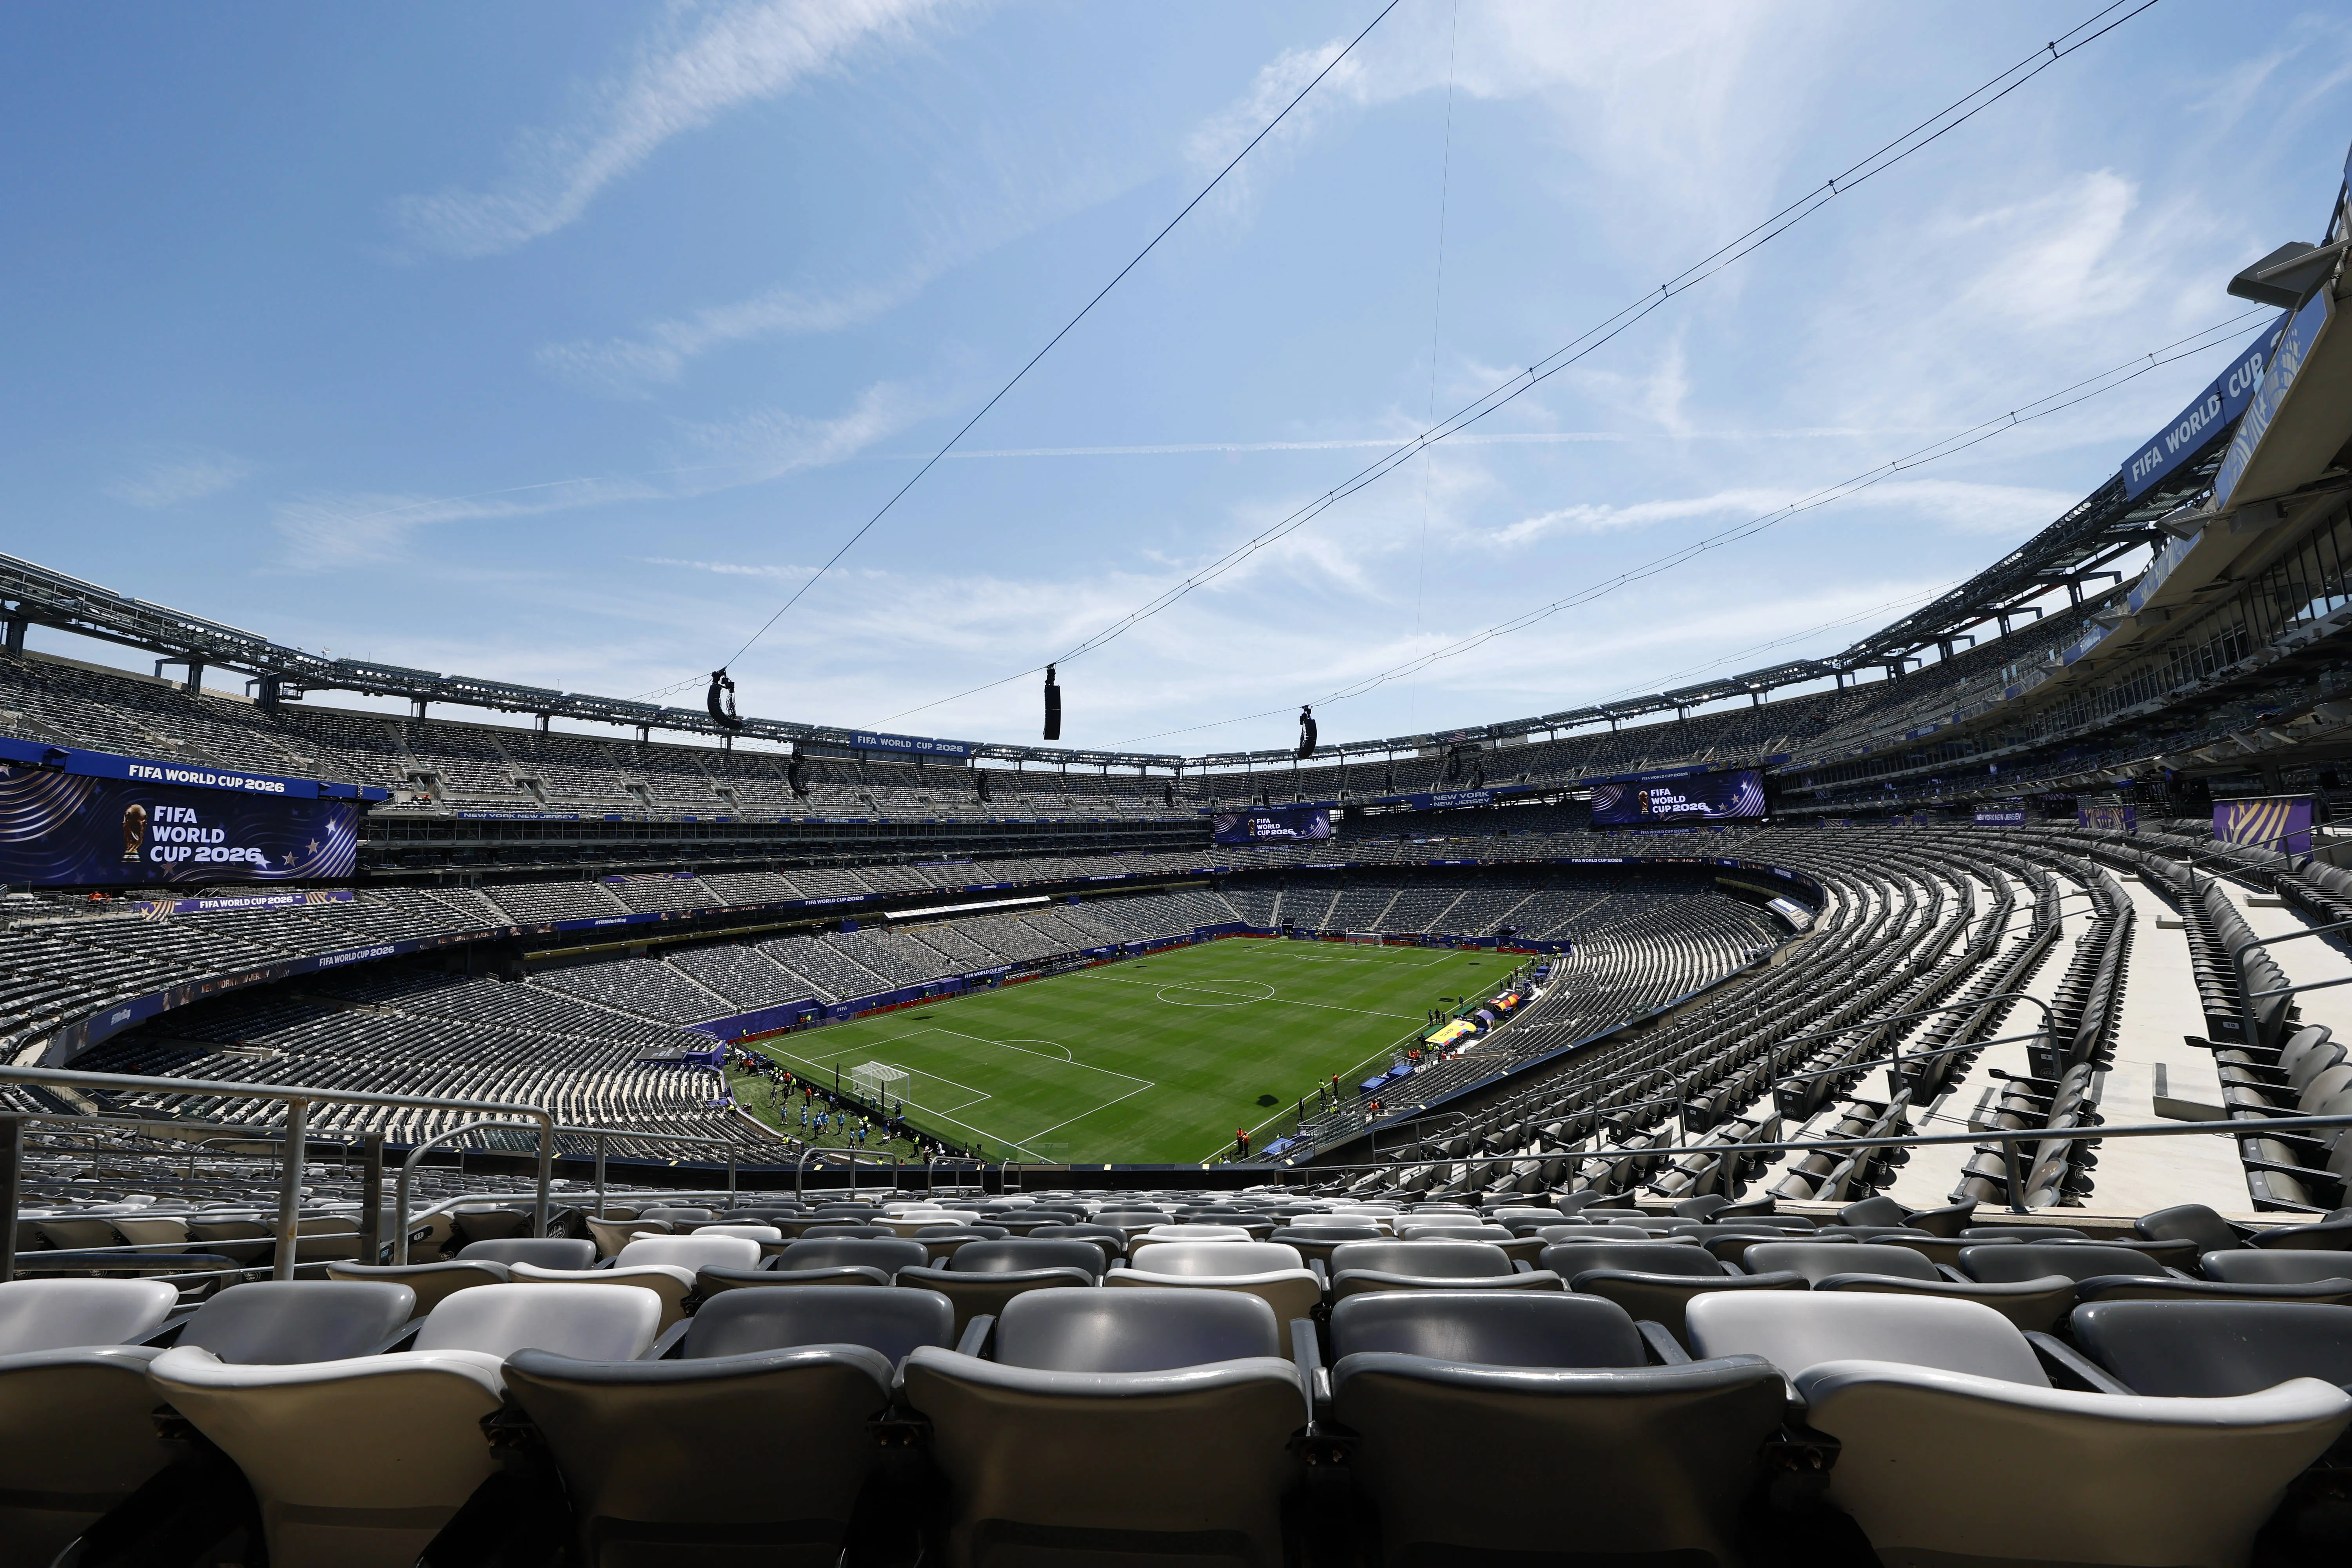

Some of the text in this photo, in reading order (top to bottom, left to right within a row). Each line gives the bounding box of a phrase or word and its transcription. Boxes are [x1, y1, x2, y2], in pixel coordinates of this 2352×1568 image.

[2132, 353, 2262, 482] FIFA WORLD CUP
[857, 736, 877, 744] FIFA
[880, 738, 911, 748] WORLD
[936, 744, 963, 752] 2026
[129, 764, 285, 793] FIFA WORLD CUP 2026
[1651, 788, 1671, 797] FIFA
[1651, 795, 1686, 805] WORLD
[154, 806, 197, 823] FIFA
[1673, 802, 1706, 812] 2026
[152, 826, 225, 843] WORLD
[150, 846, 261, 862] CUP 2026
[220, 898, 250, 907] WORLD
[319, 946, 394, 967] FIFA WORLD CUP 2026
[201, 984, 215, 993] NE
[235, 975, 248, 985] NW
[249, 970, 270, 982] JERY
